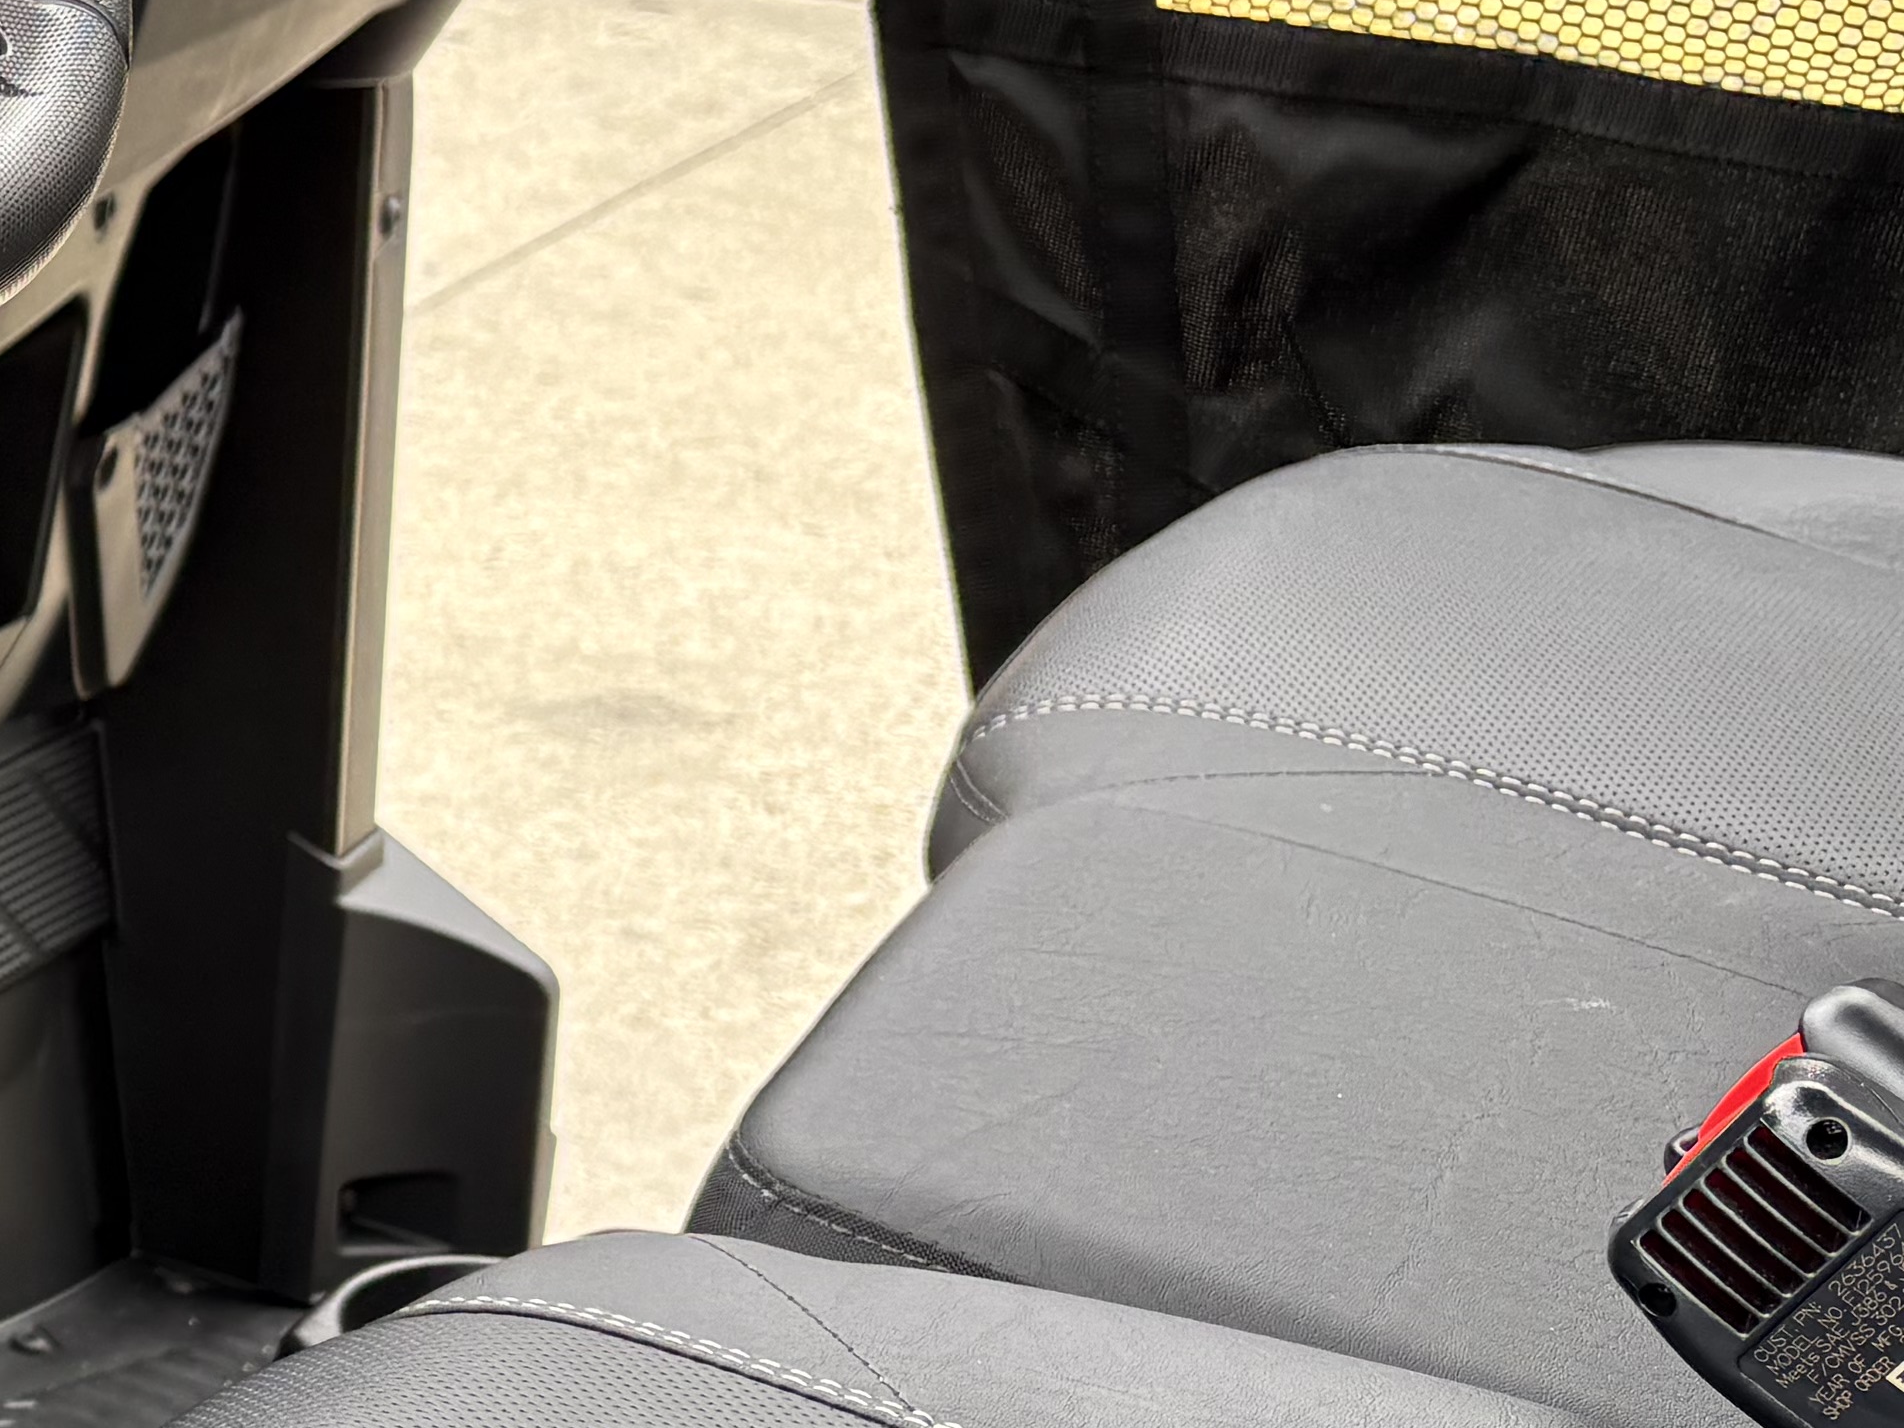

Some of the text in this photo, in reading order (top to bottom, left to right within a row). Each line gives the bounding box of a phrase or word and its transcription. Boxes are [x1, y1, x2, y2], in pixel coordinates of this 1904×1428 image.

[1754, 1324, 1799, 1362] CUST.
[1828, 1223, 1902, 1296] 2636437
[1767, 1334, 1820, 1375] MODEL
[1818, 1307, 1848, 1329] NO.
[1776, 1287, 1887, 1389] Meets SAE J386
[1807, 1296, 1904, 1385] F/CMVSS 302
[1809, 1373, 1851, 1406] YEAR
[1848, 1353, 1866, 1373] OF
[1823, 1356, 1895, 1420] SHOP ORDER
